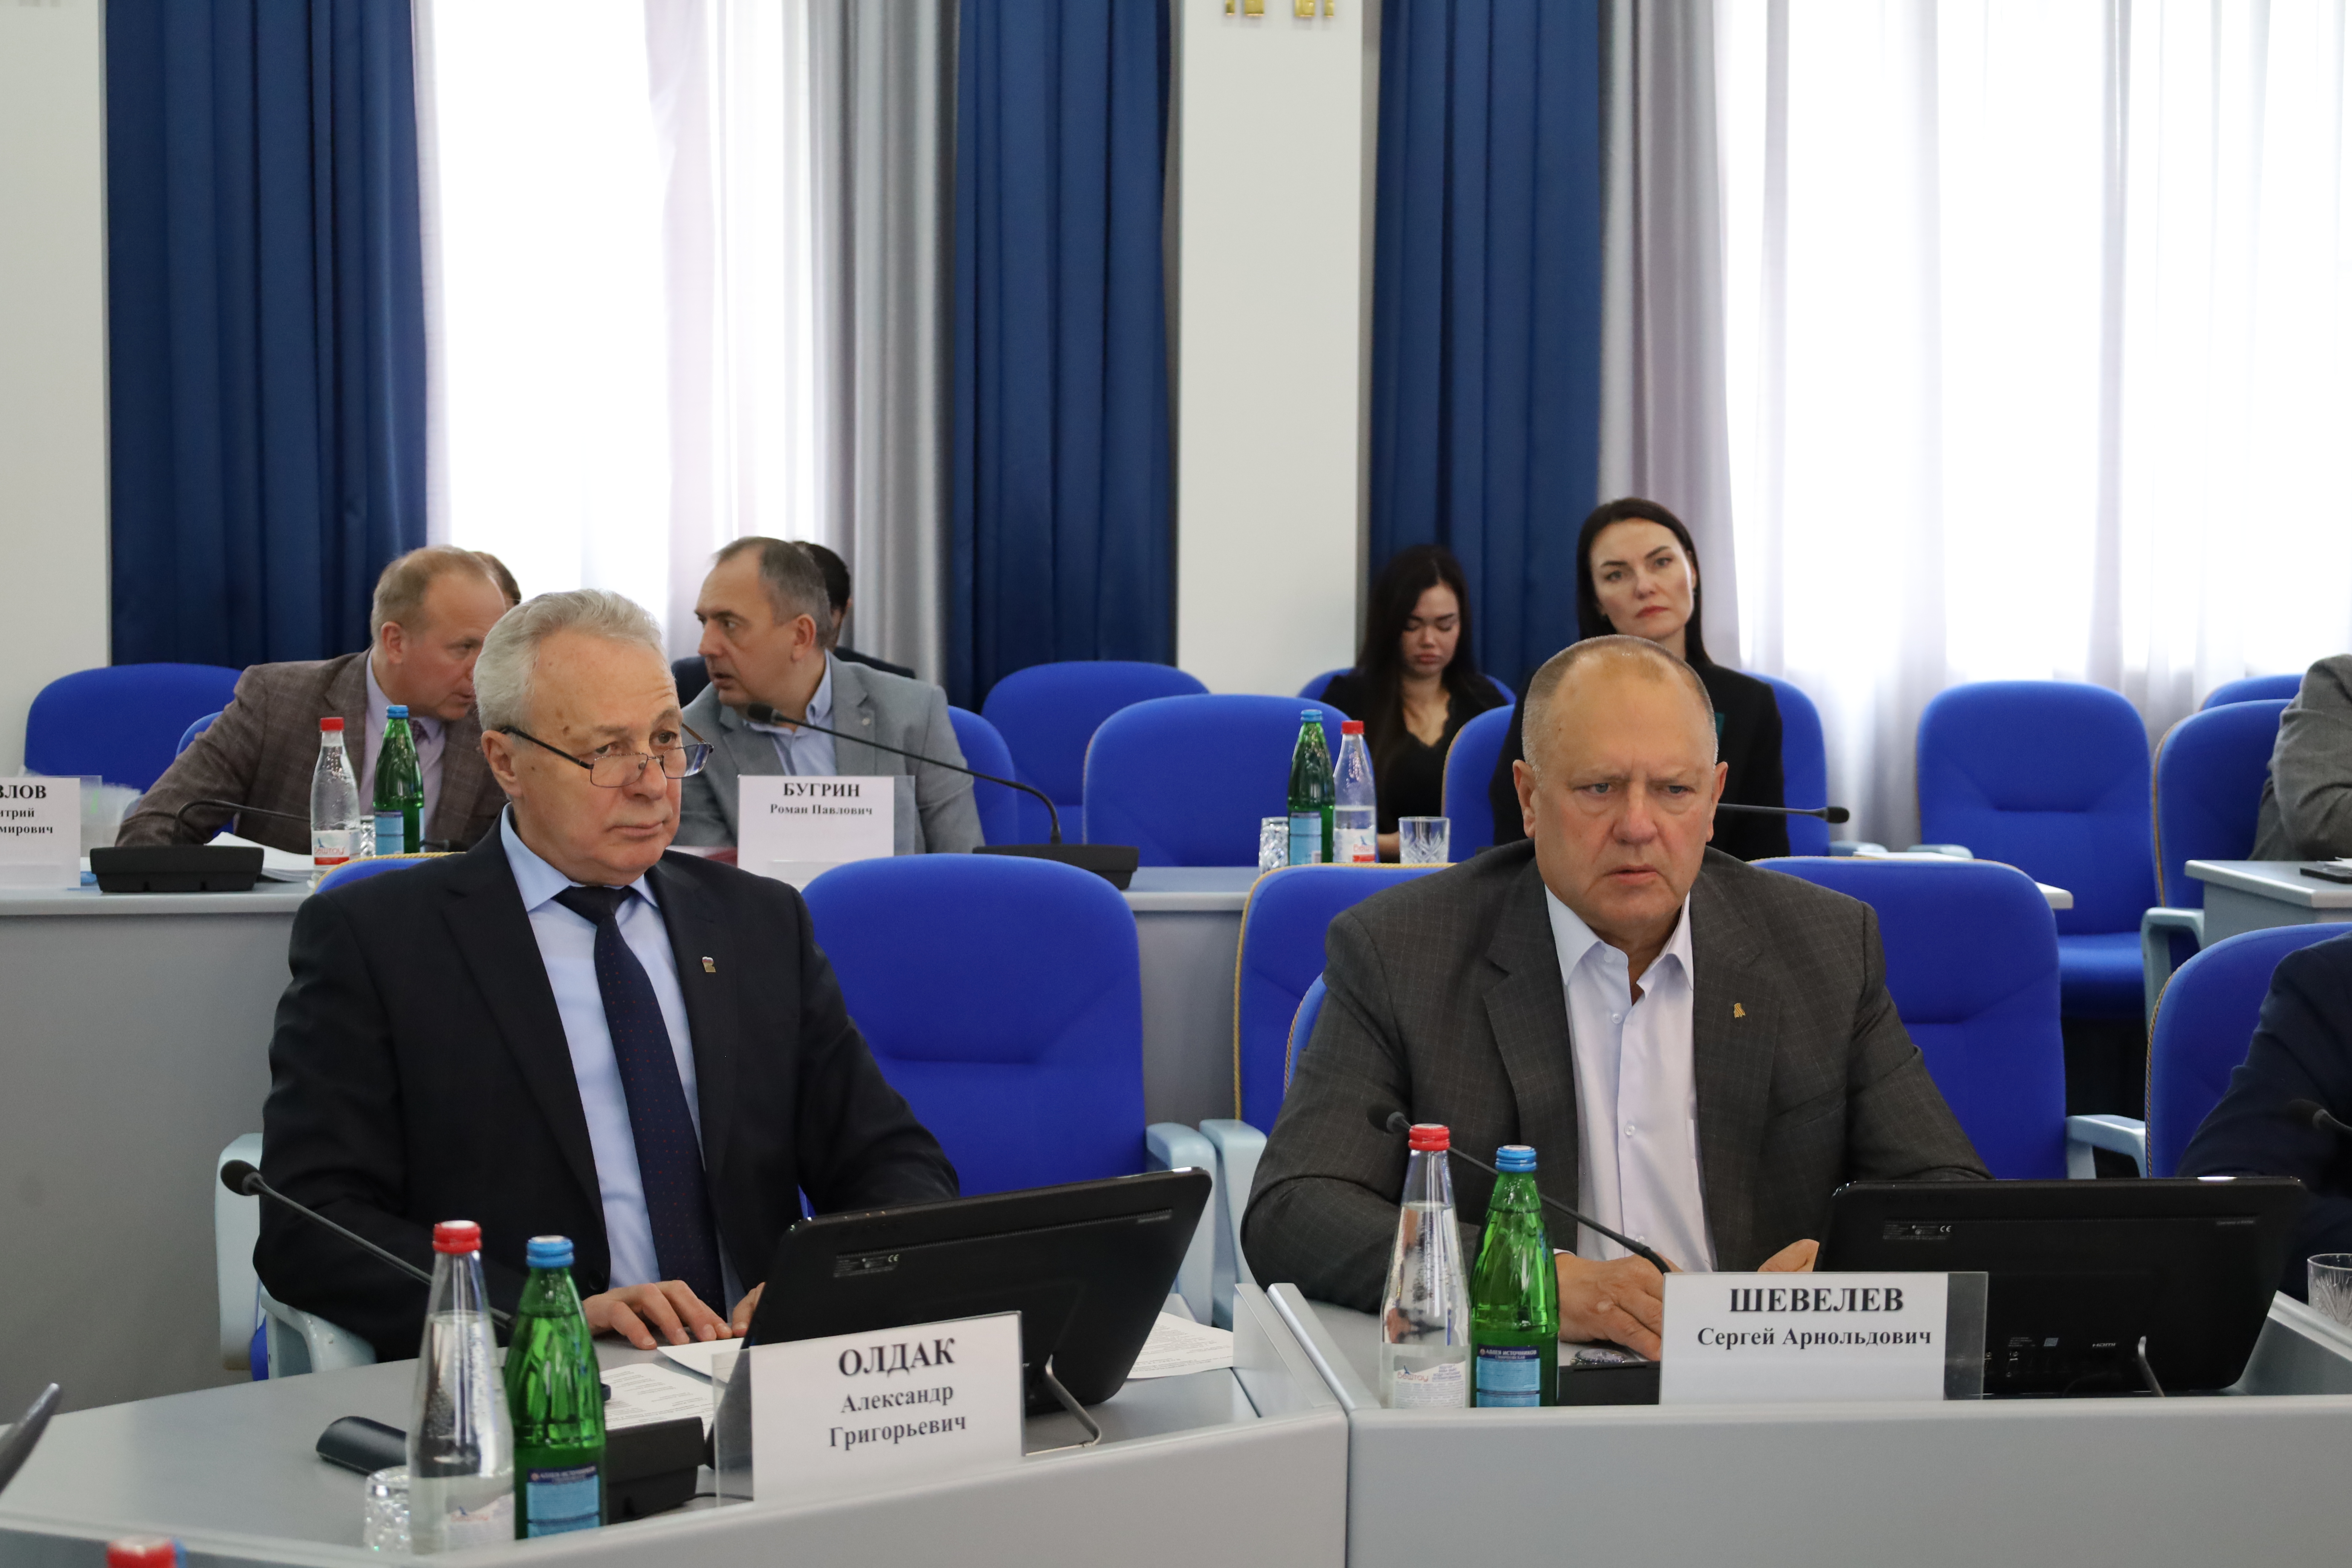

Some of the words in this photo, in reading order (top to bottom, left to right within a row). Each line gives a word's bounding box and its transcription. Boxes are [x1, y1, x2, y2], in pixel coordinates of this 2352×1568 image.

[784, 783, 860, 797] БУГРИН
[770, 804, 808, 814] Роман
[812, 804, 873, 815] Павлович
[1729, 1288, 1904, 1312] ШЕВЕЛЕВ
[1697, 1327, 1775, 1351] Сергей
[1782, 1328, 1932, 1350] Арнольдович
[838, 1337, 956, 1378] ОЛДАК
[841, 1386, 954, 1413] Александр
[829, 1416, 967, 1451] Григорьевич
